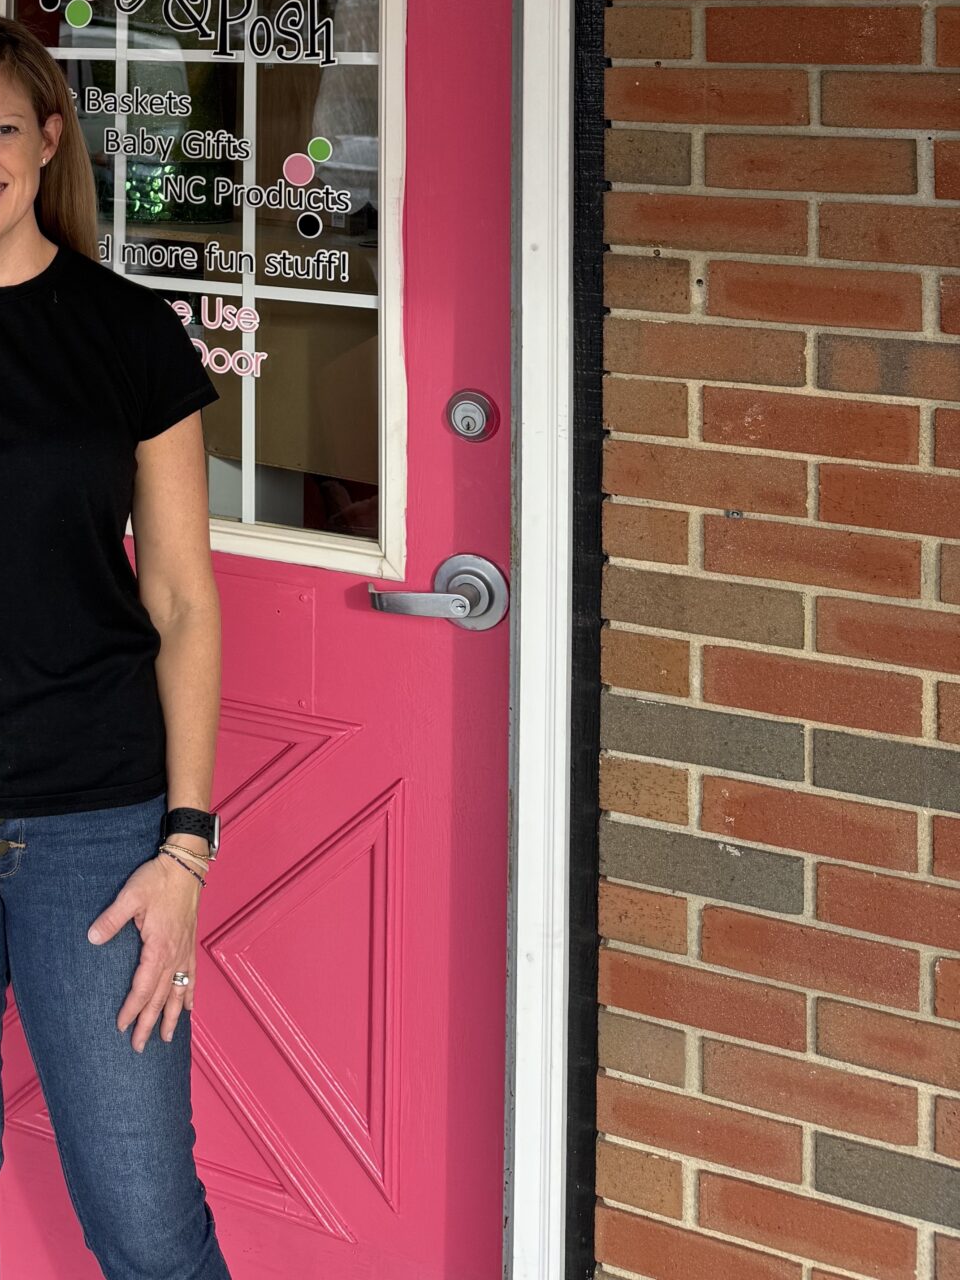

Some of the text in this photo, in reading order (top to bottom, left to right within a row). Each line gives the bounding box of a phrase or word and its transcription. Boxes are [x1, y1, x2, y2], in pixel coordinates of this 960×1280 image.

[84, 86, 192, 117] Baskets
[103, 127, 252, 162] Baby Gifts
[163, 175, 351, 213] NC Products
[120, 242, 198, 269] more
[205, 240, 255, 274] fun
[264, 249, 350, 282] stuff!
[200, 295, 260, 333] Use
